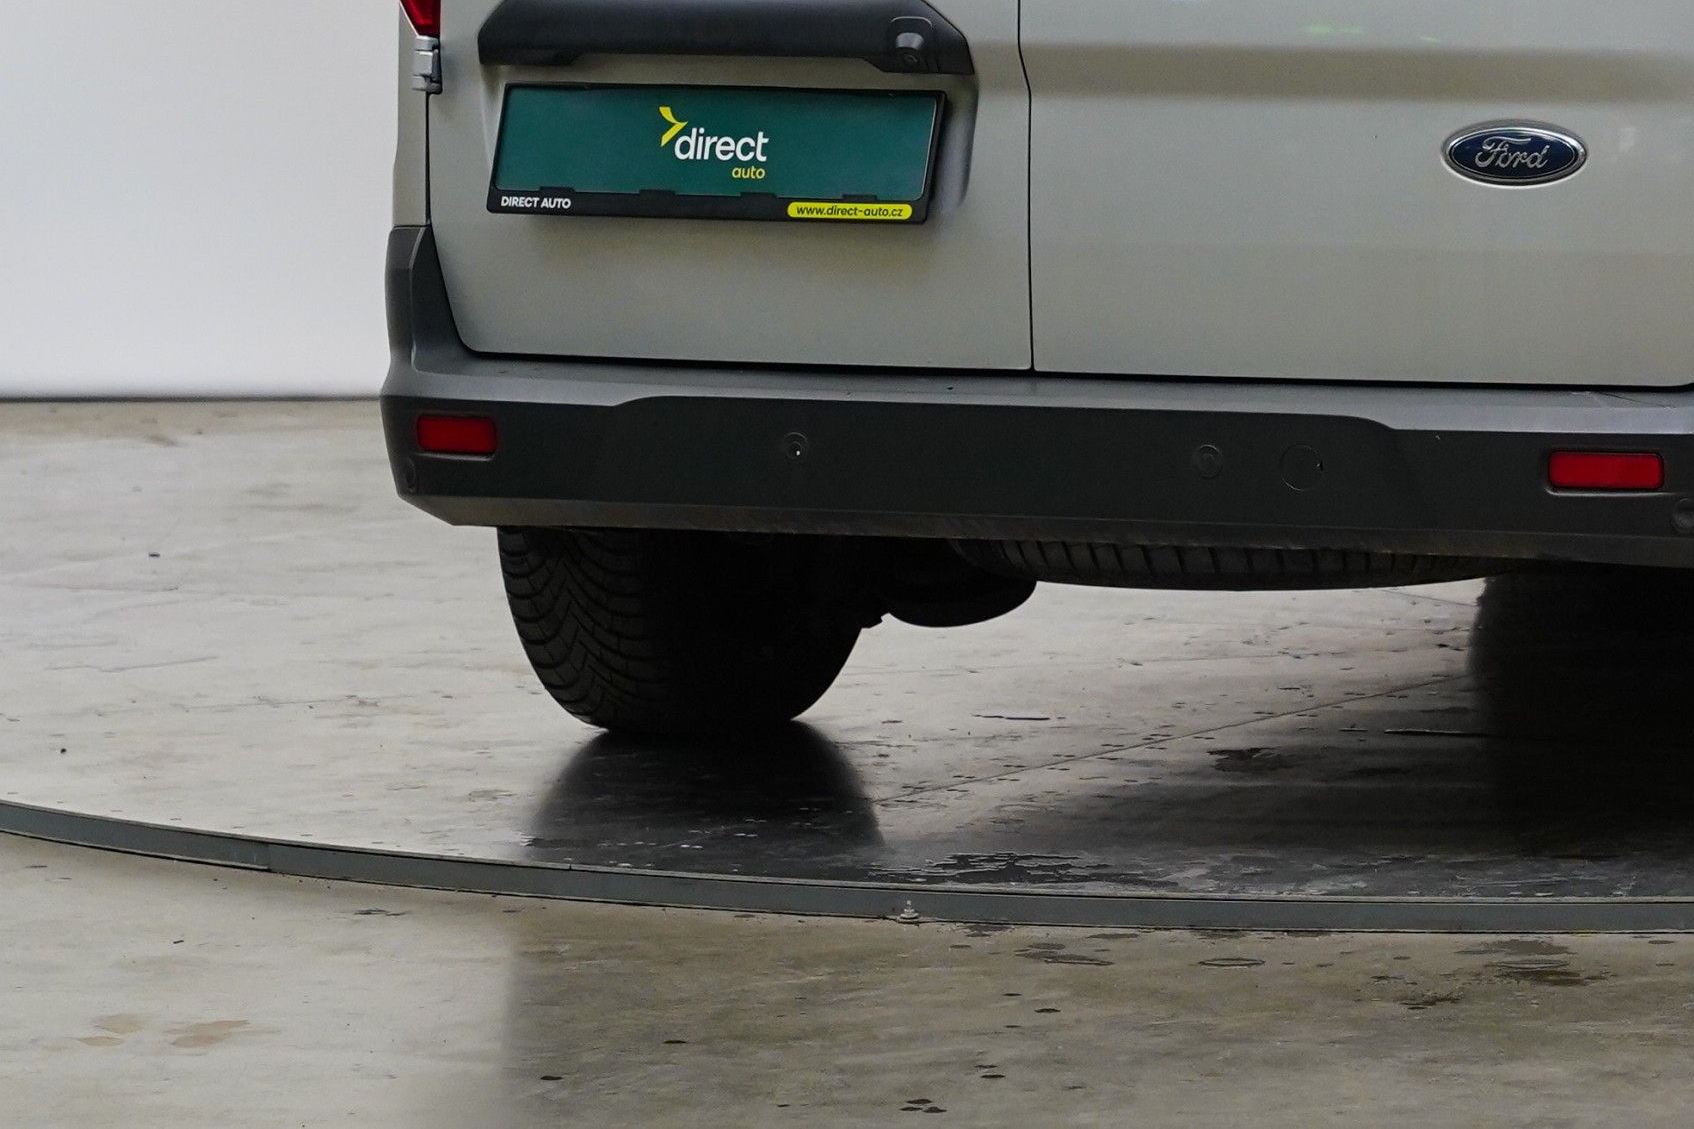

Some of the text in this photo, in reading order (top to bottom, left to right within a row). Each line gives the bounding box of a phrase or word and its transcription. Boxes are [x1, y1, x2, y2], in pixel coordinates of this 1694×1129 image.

[674, 127, 769, 161] direct
[1475, 136, 1550, 168] Ford
[732, 166, 765, 179] auto
[501, 196, 572, 209] DIRECT AUTO
[797, 205, 903, 217] www.direct-auto.cz
